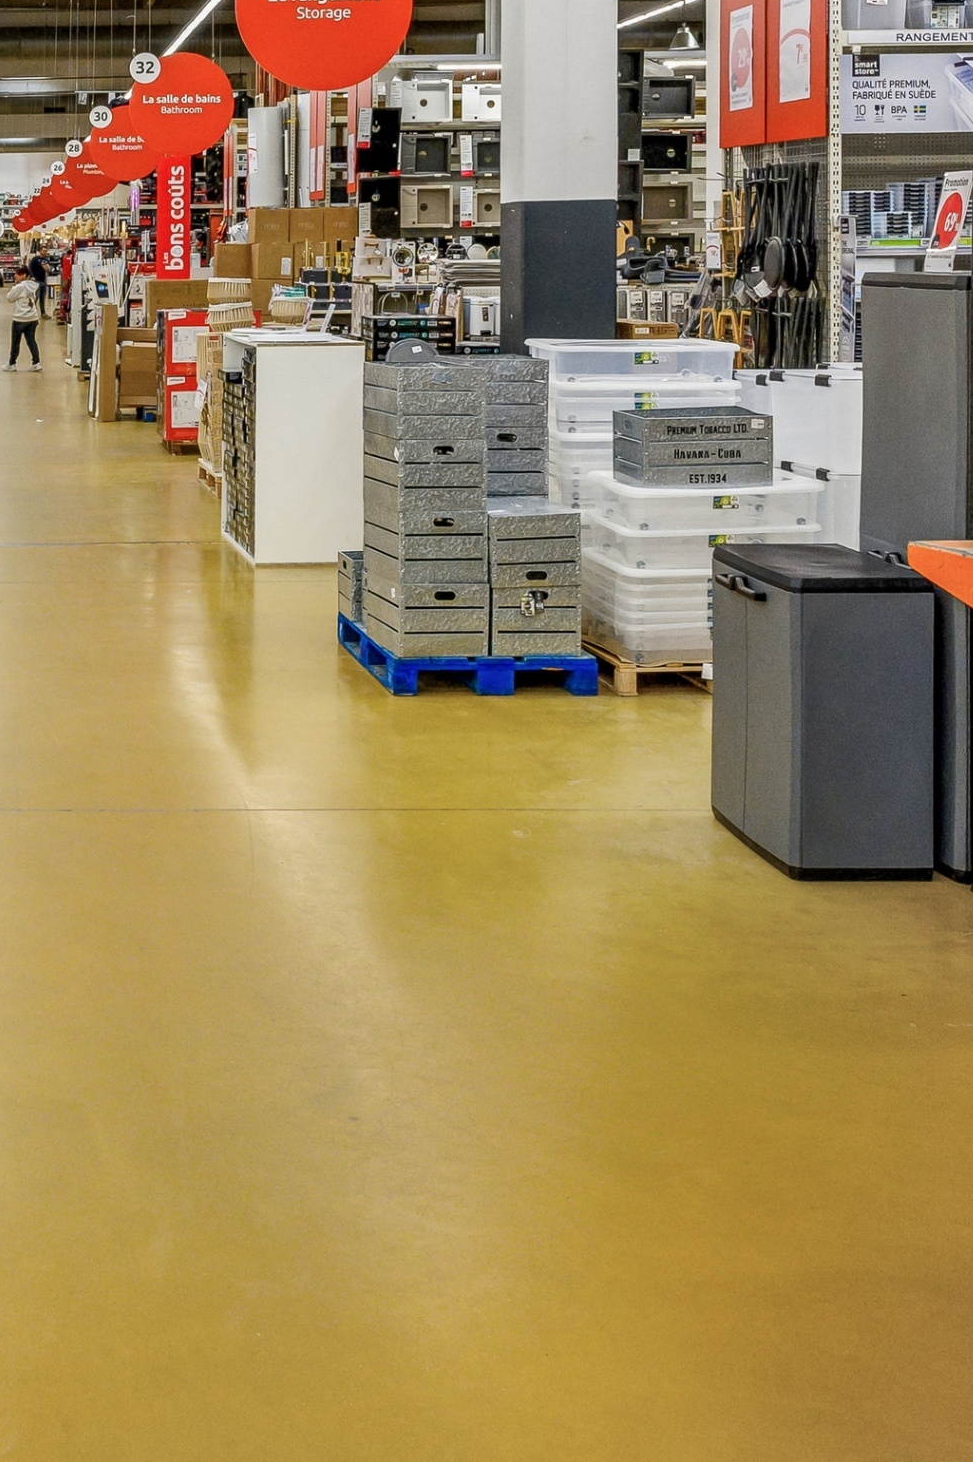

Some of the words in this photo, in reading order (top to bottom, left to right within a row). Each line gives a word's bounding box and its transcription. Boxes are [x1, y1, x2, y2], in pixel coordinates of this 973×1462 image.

[296, 6, 352, 21] Storage
[135, 61, 155, 74] 32
[852, 78, 887, 89] QUALITÉ
[889, 80, 931, 89] PREMIUM,
[142, 94, 154, 104] La
[156, 94, 180, 104] salle
[181, 94, 194, 104] de
[196, 92, 222, 104] bains
[852, 89, 892, 100] FABRIQUÉ
[895, 91, 906, 99] EN
[908, 89, 936, 99] SUÈDE
[160, 105, 203, 115] Bathroom
[854, 104, 866, 116] 10
[891, 106, 908, 114] BPA
[94, 112, 108, 122] 30
[68, 144, 80, 152] 28
[54, 164, 62, 172] 26
[945, 177, 968, 188] Promotion
[168, 166, 184, 220] coûts
[165, 223, 184, 270] bons
[666, 424, 697, 436] PREMIUM
[699, 424, 731, 434] TOBACCO
[733, 424, 749, 434] LTD.
[689, 473, 727, 484] EST.1934
